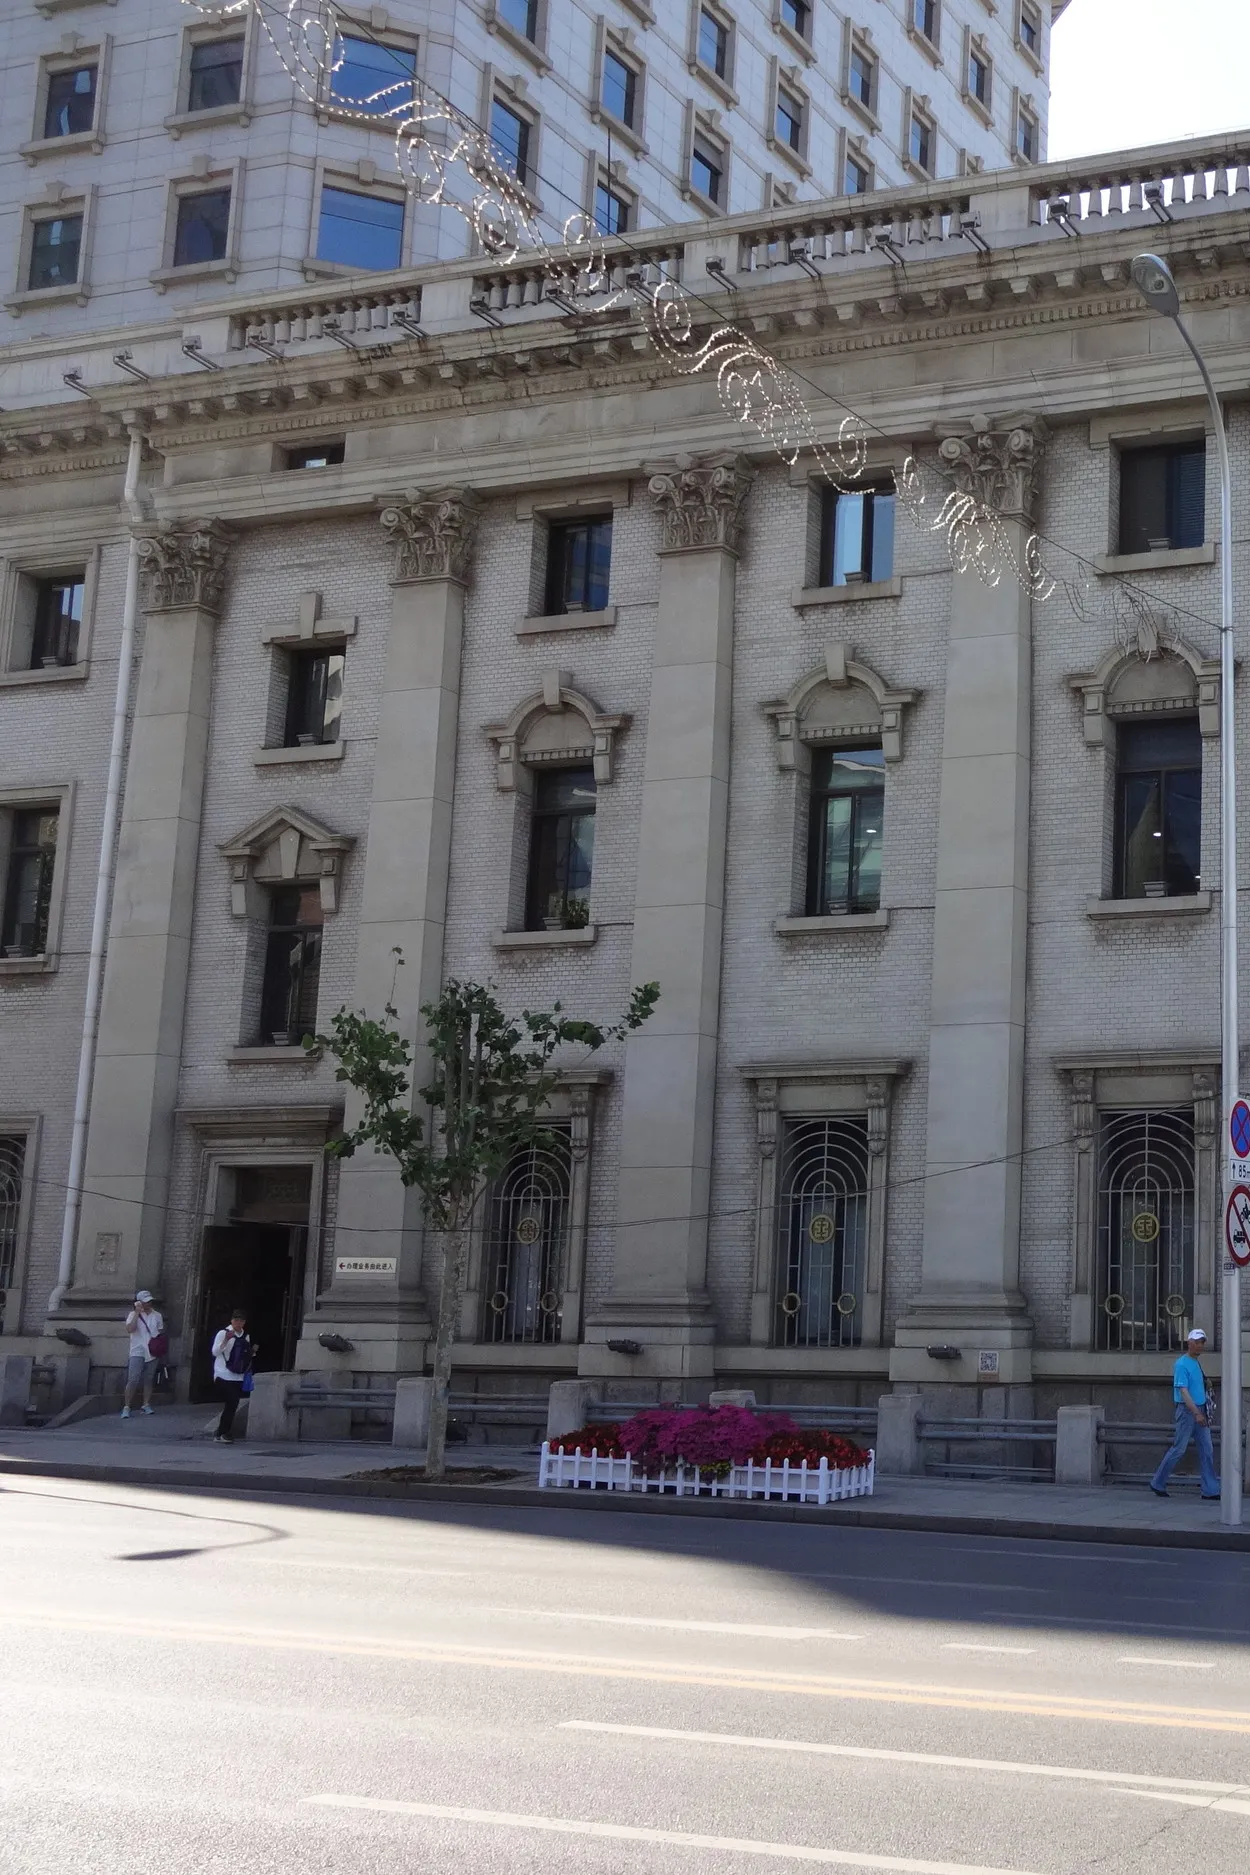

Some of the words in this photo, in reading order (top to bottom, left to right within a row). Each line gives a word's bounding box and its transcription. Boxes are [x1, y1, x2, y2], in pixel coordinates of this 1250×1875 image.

[1238, 1164, 1250, 1178] 85m
[346, 1262, 393, 1270] 办理业务由此进入
